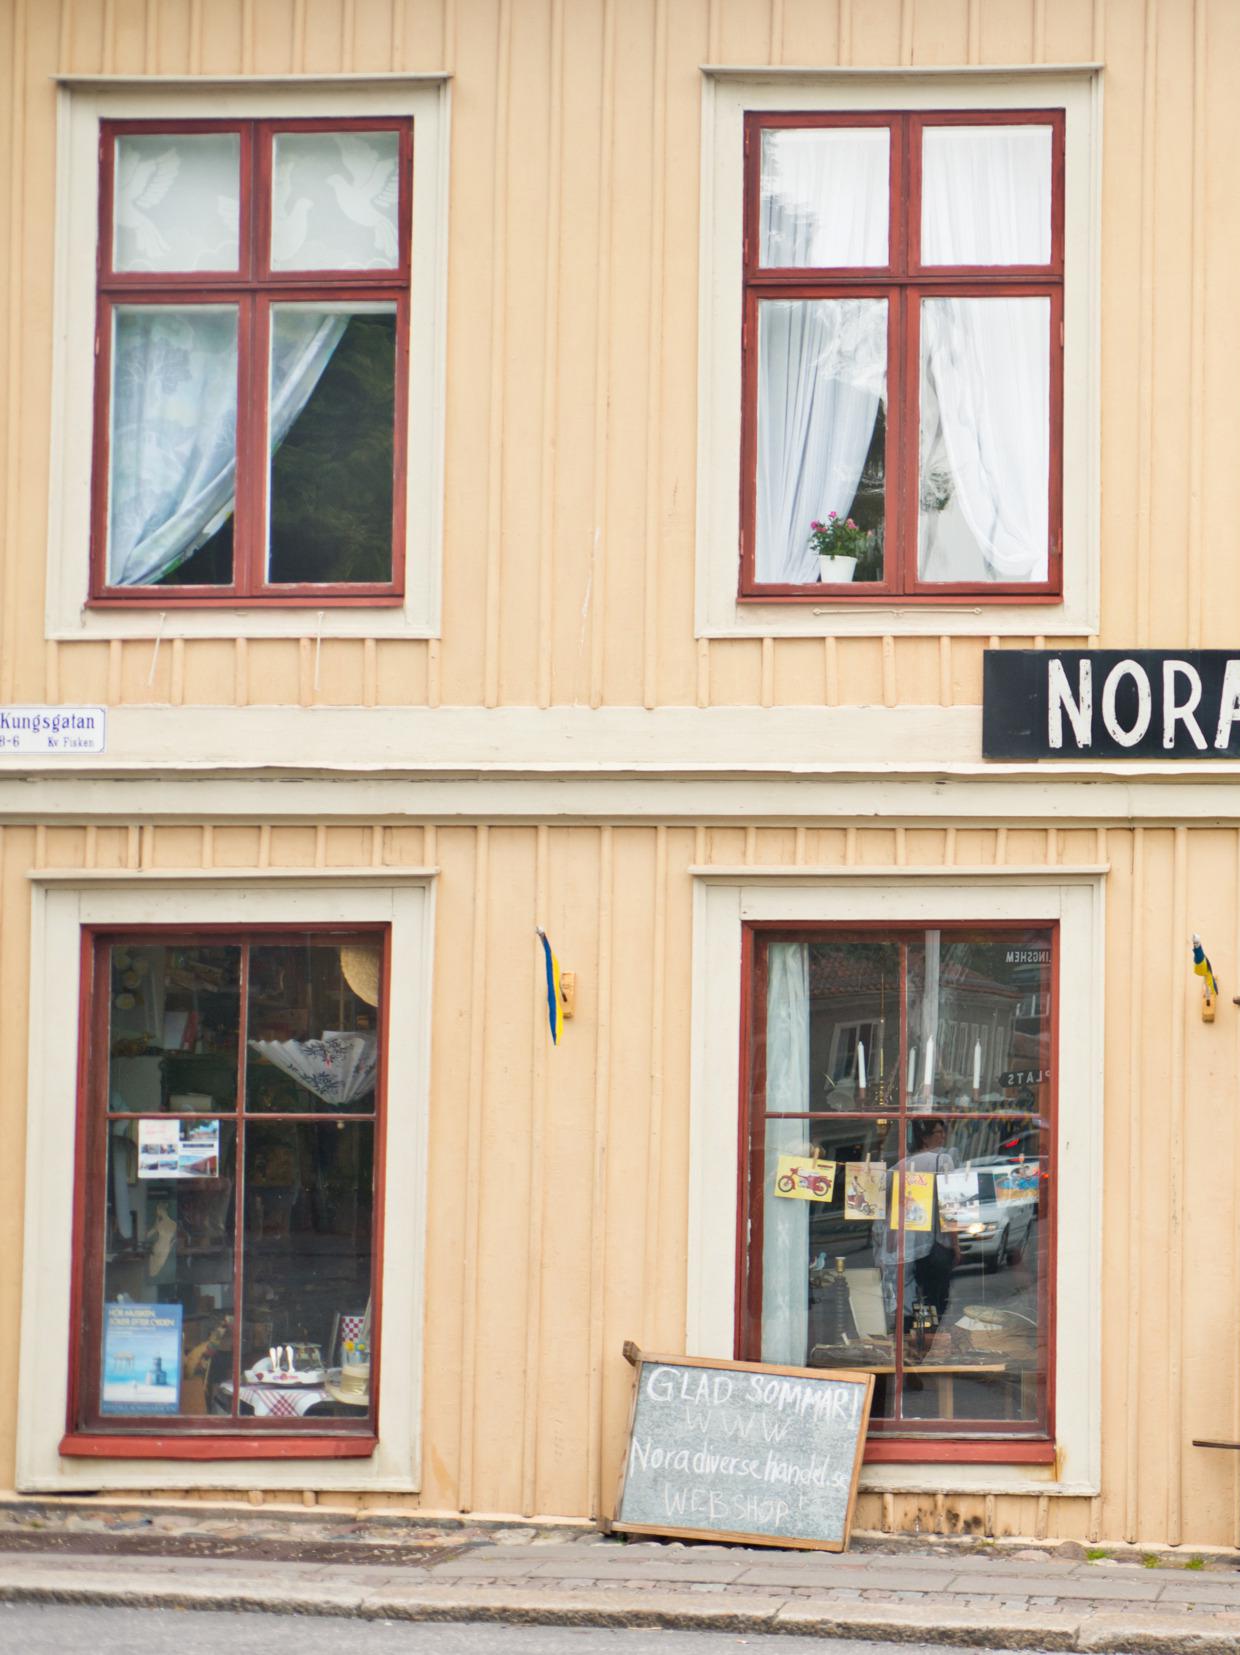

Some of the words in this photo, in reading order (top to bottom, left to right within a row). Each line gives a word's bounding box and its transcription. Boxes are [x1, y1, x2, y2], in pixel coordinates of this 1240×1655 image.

[0, 712, 95, 733] Kungsgatan
[63, 736, 94, 748] Fisken
[646, 1367, 733, 1405] GLAD
[746, 1374, 860, 1430] SOMMAR!
